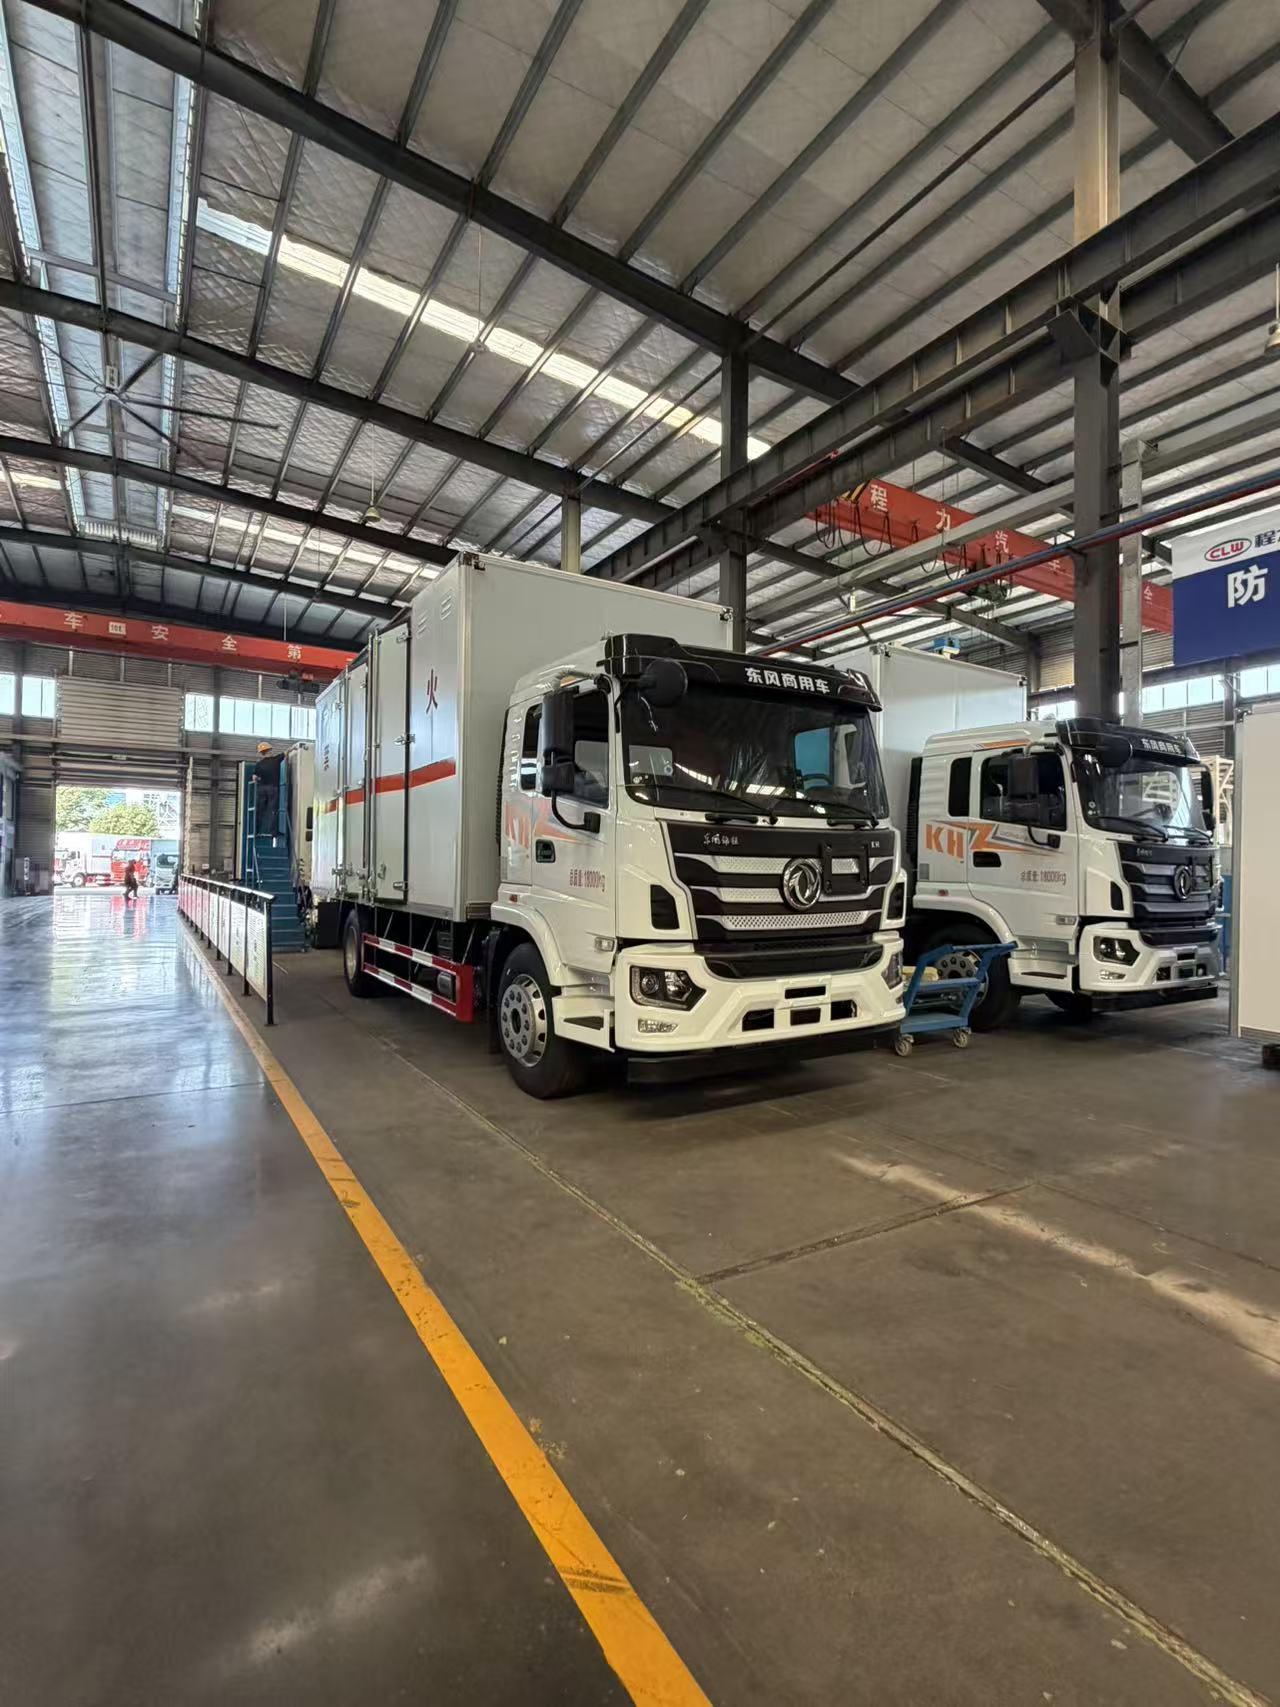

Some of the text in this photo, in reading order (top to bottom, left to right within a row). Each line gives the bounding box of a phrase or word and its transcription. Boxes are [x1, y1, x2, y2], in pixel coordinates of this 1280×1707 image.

[1209, 541, 1244, 559] CLW
[1255, 529, 1280, 548] 程
[1227, 564, 1268, 608] 防
[425, 668, 438, 714] 火
[745, 667, 830, 694] 东风商用车
